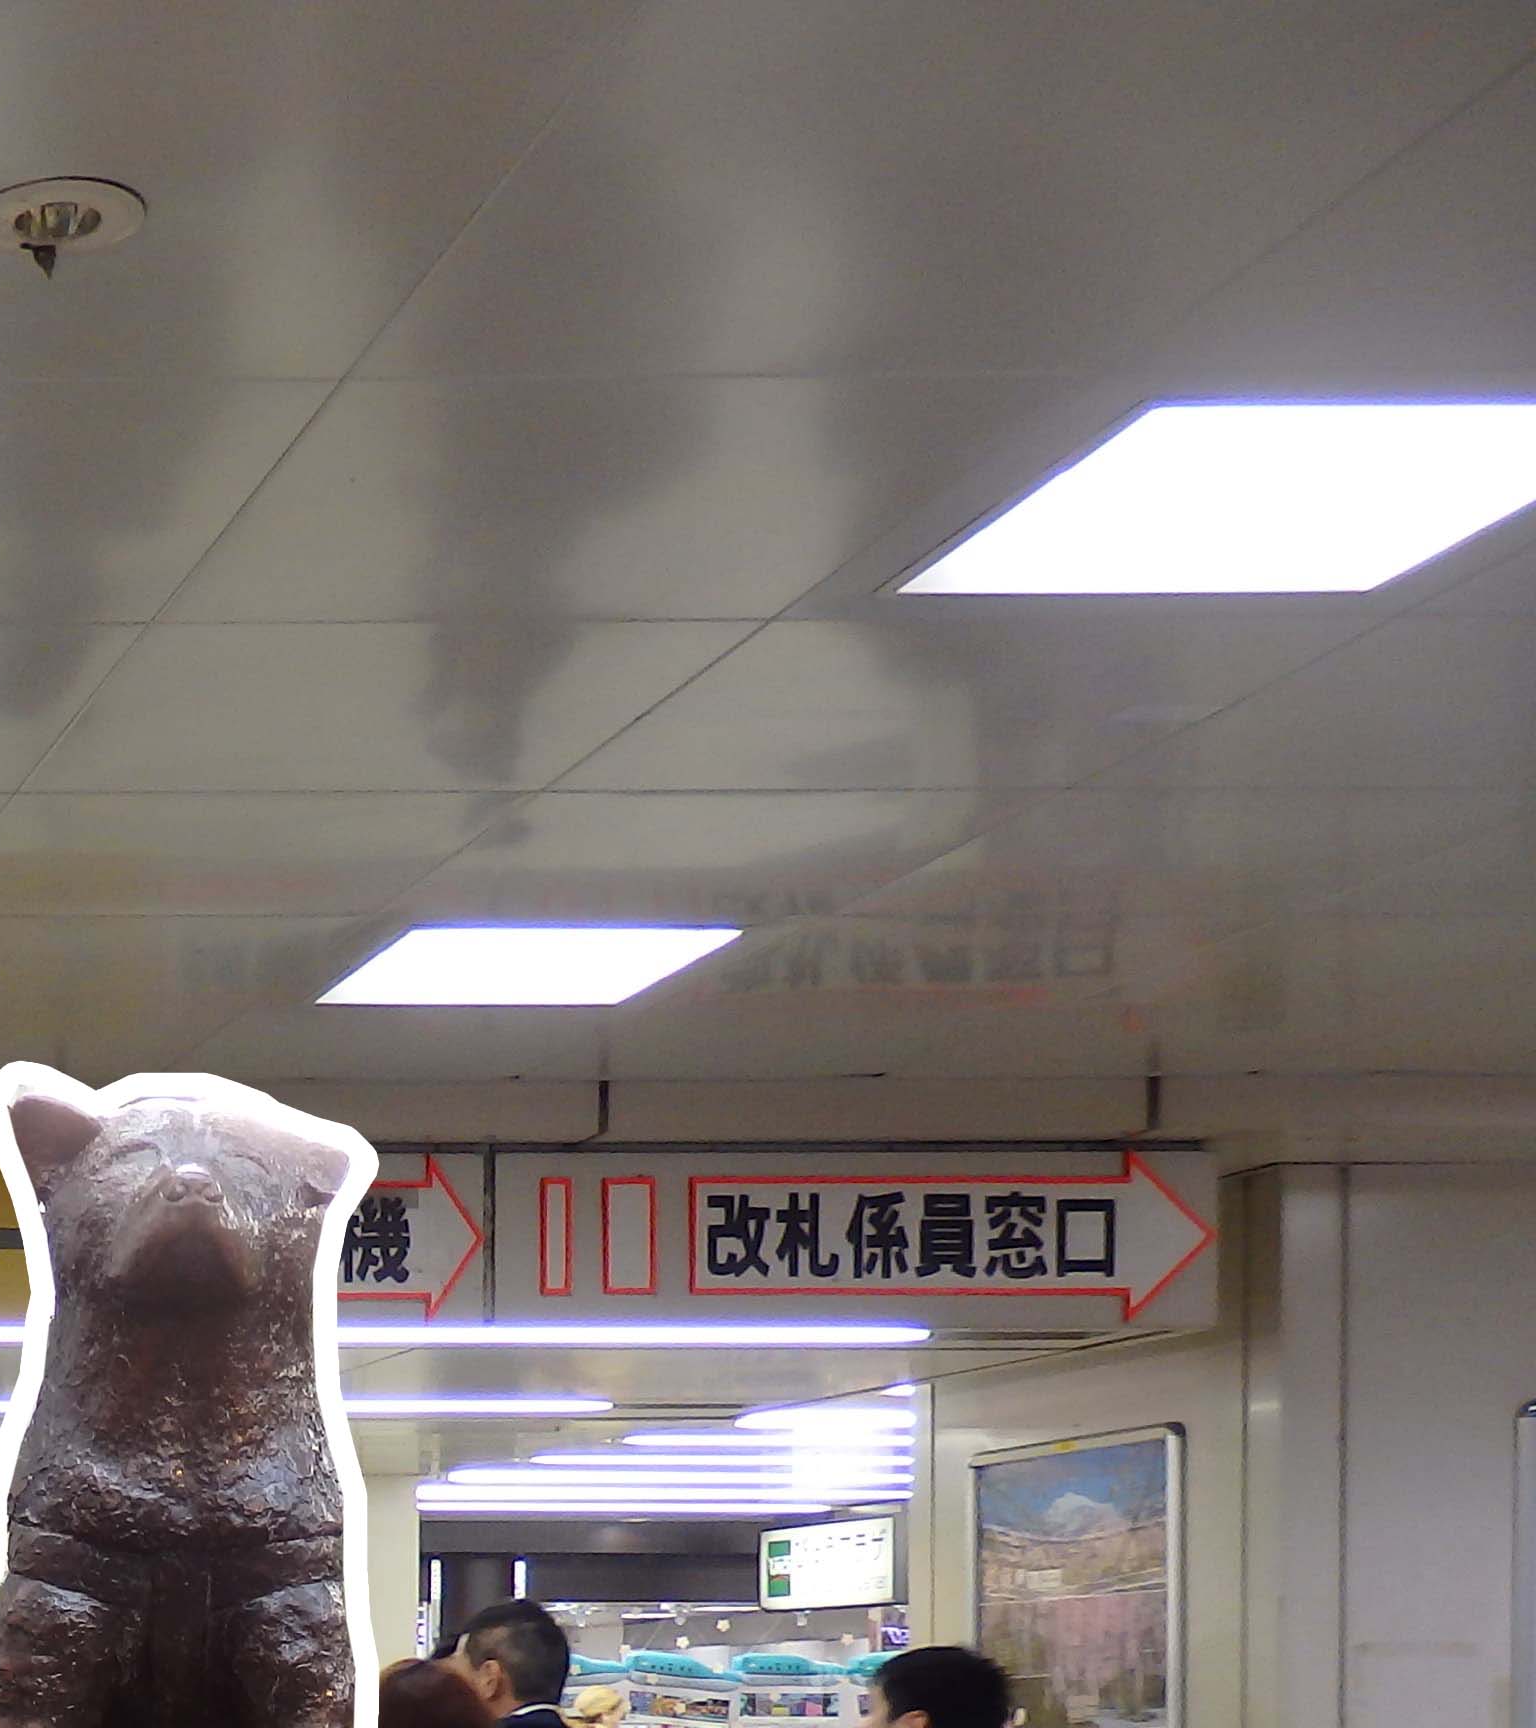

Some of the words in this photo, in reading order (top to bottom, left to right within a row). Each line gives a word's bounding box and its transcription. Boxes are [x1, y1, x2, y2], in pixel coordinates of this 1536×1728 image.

[705, 1192, 1120, 1281] 改札係員窓口
